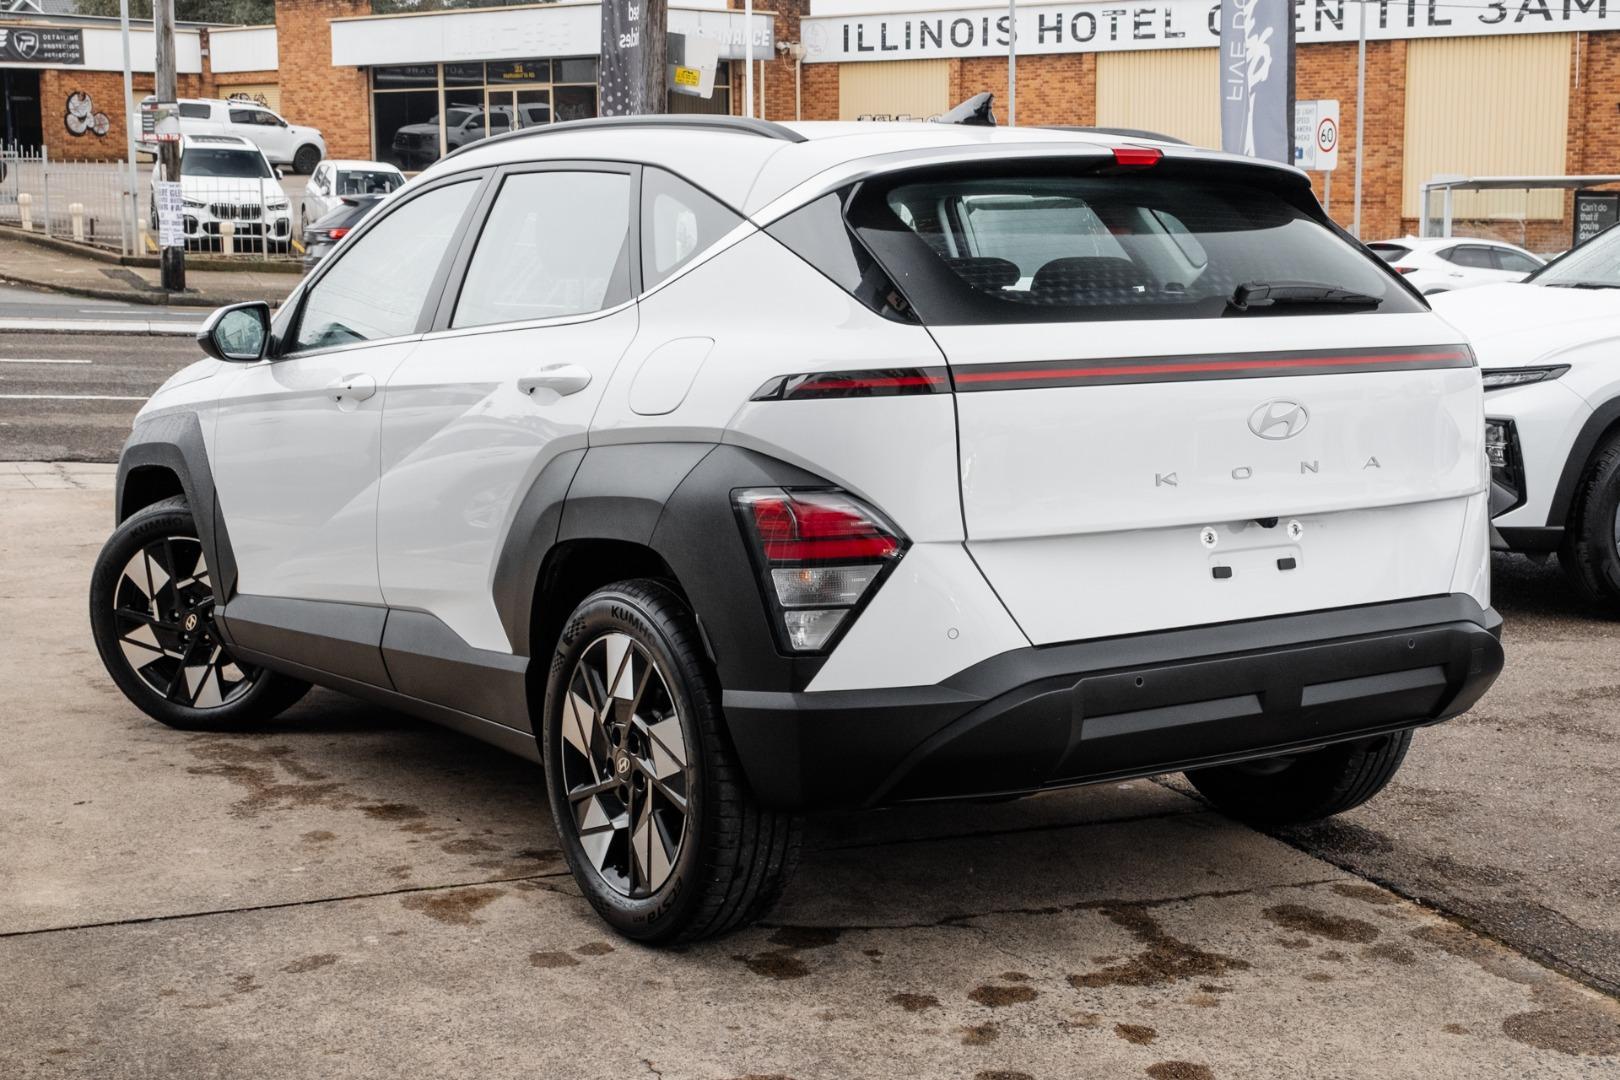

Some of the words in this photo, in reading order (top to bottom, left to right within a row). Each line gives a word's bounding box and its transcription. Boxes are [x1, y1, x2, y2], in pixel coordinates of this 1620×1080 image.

[843, 15, 1017, 52] ILLINOIS
[1038, 8, 1185, 44] HOTEL
[1478, 0, 1607, 24] 3AM
[1321, 128, 1333, 143] 60
[1580, 202, 1597, 212] Can't
[1598, 202, 1608, 212] do
[1580, 212, 1593, 221] that
[1593, 212, 1599, 221] if
[1155, 456, 1382, 487] KONA
[131, 517, 183, 536] KUMHO
[611, 604, 657, 648] KUMHO
